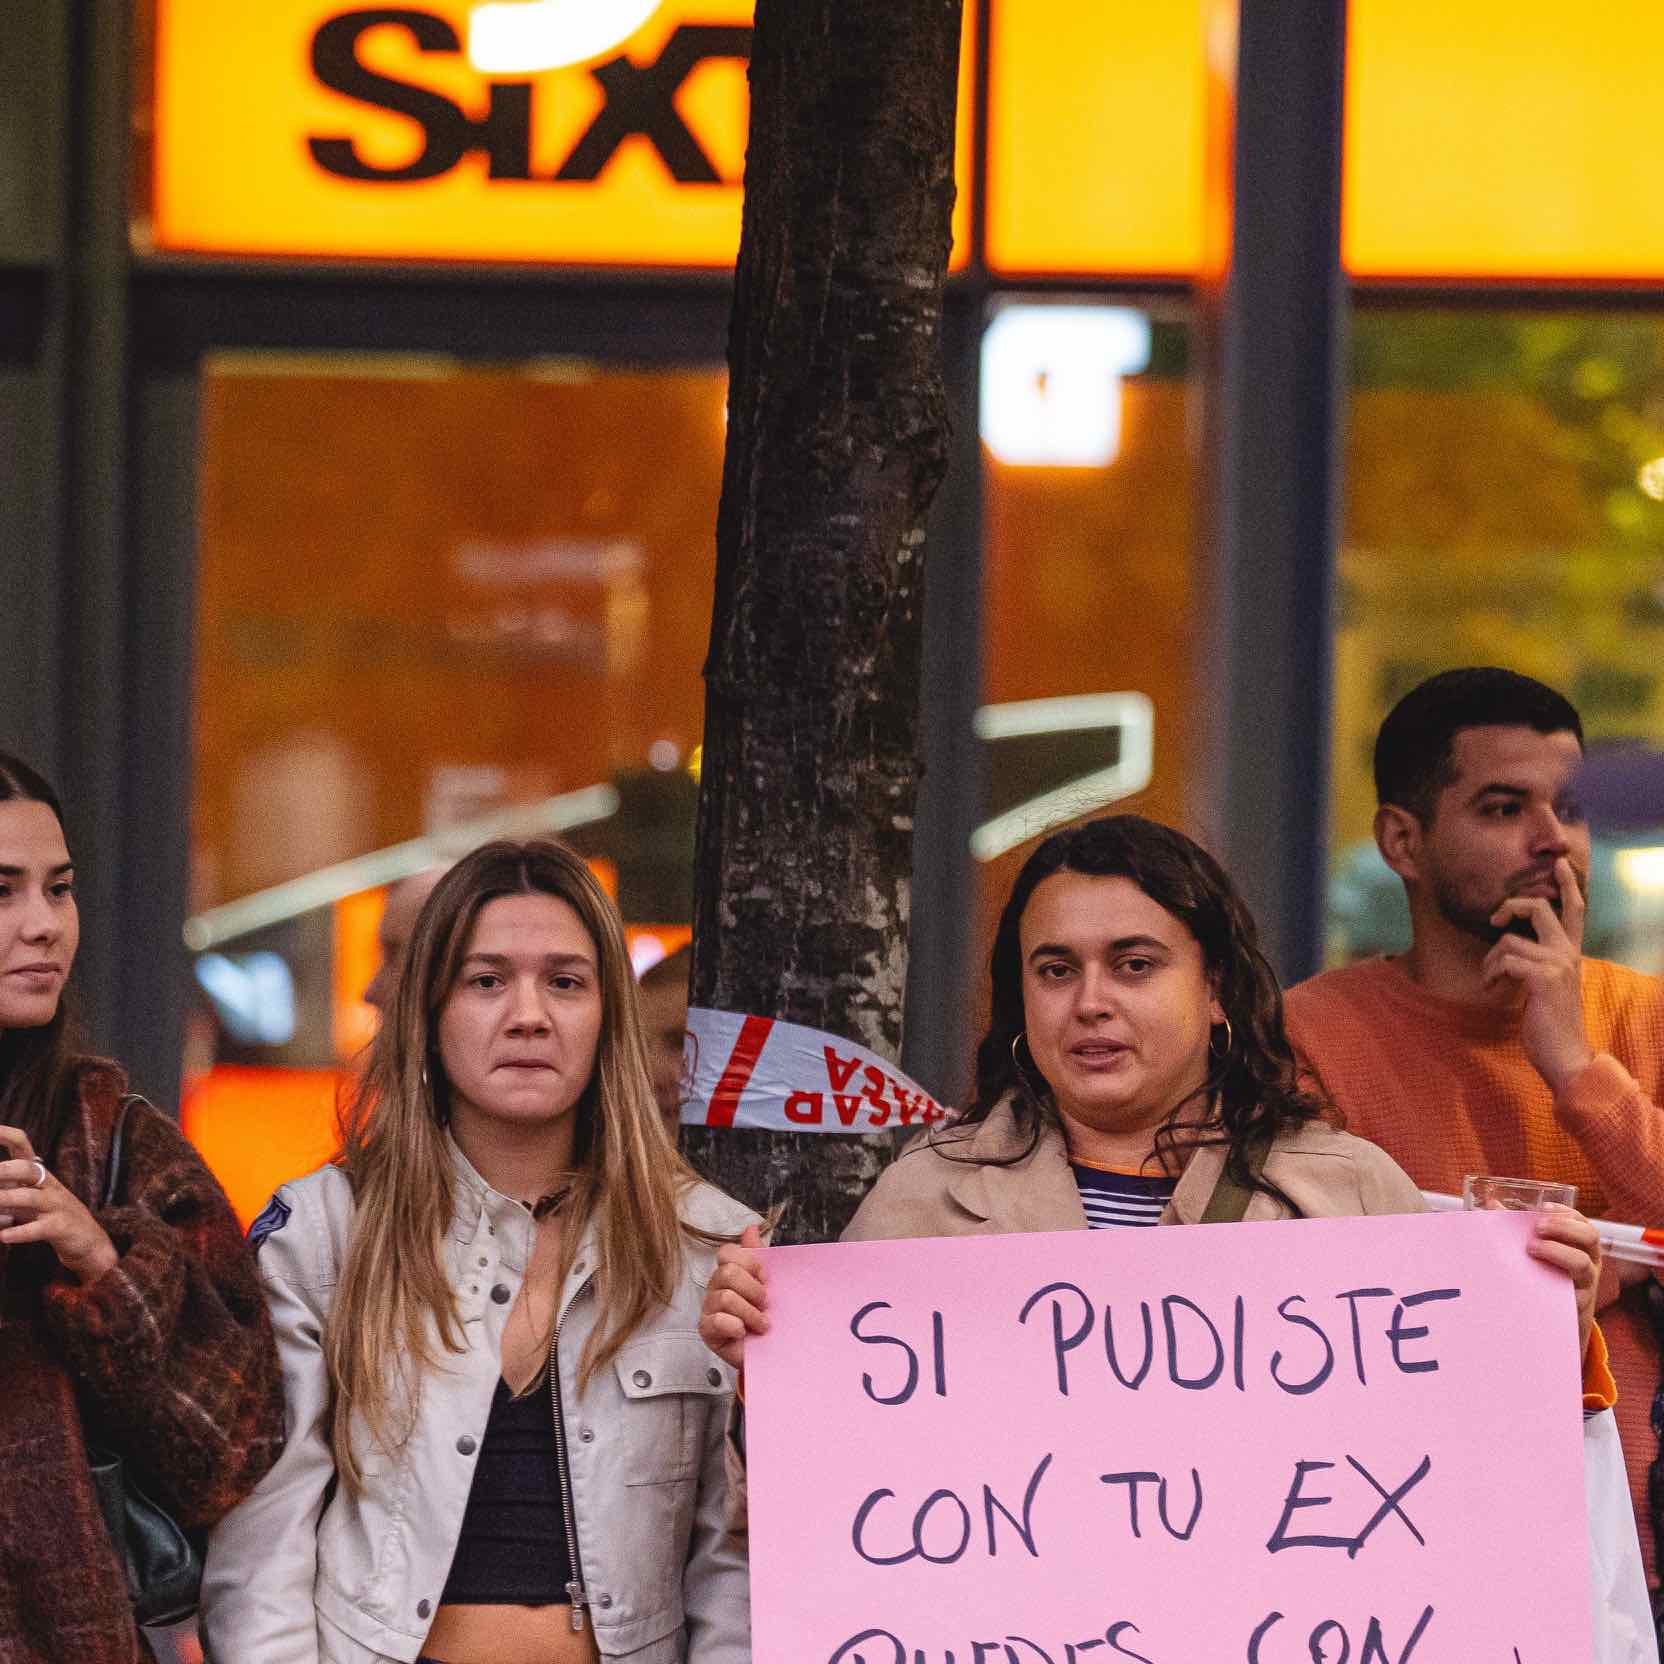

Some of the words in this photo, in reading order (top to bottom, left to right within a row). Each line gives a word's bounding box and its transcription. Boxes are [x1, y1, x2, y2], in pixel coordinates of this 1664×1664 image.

[849, 1300, 947, 1407] SI
[1018, 1281, 1461, 1397] PUDISTE
[851, 1453, 1053, 1567] CON
[1100, 1468, 1203, 1541] TU
[1265, 1454, 1431, 1561] EX
